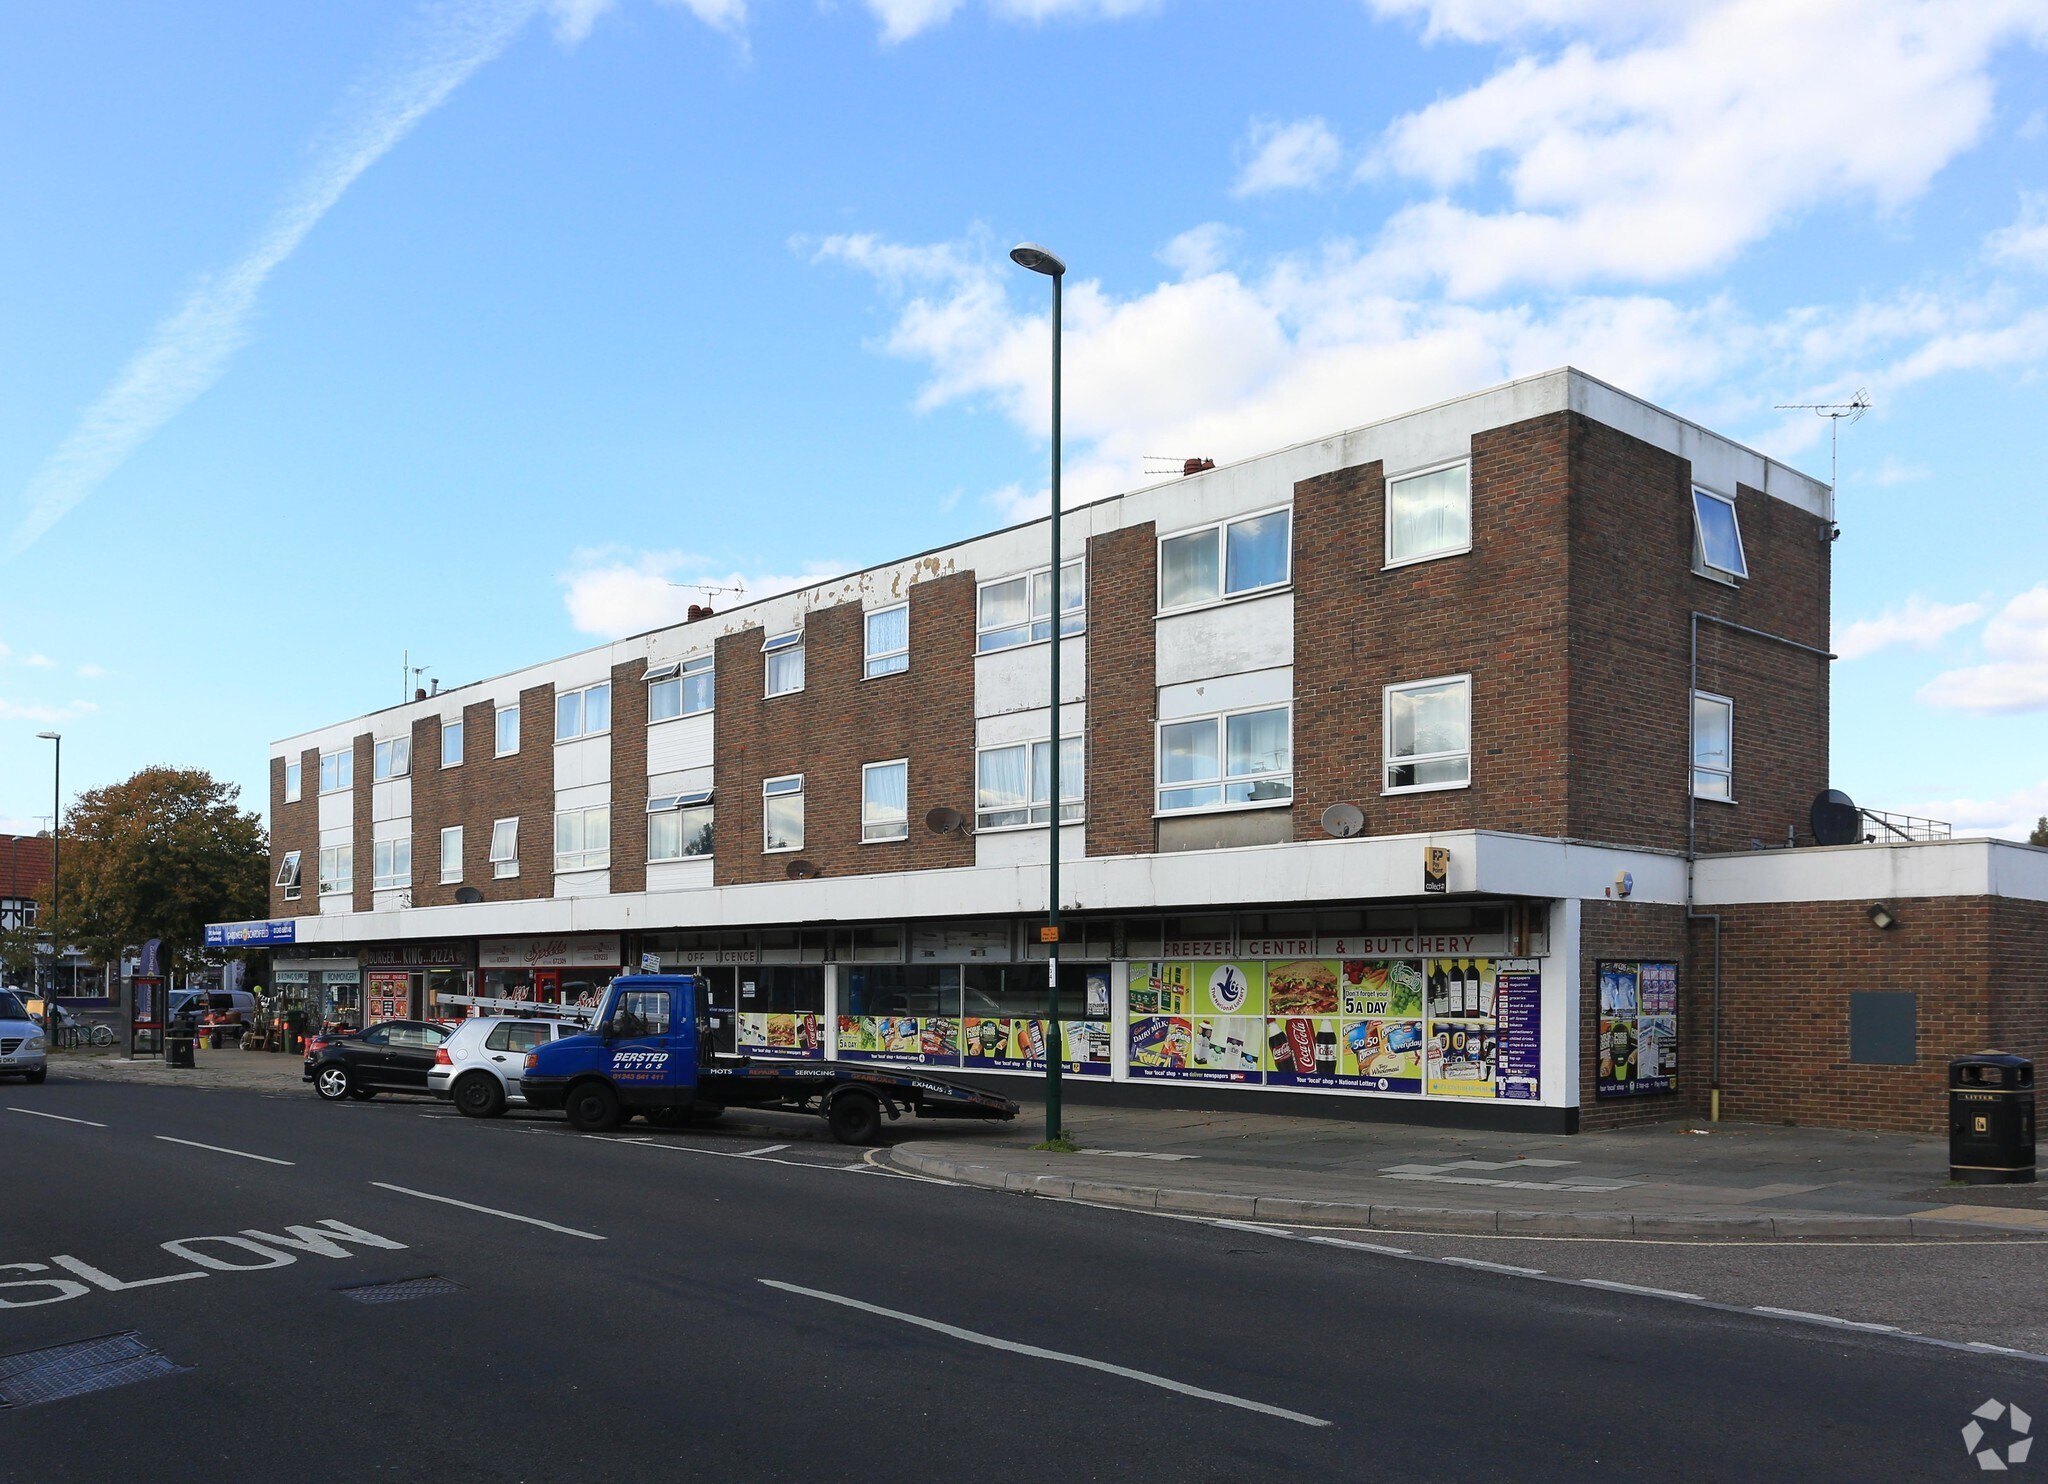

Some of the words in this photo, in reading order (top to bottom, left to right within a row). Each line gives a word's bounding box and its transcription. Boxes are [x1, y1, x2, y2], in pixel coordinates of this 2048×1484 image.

[1336, 939, 1346, 954] &
[1364, 936, 1474, 954] BUTCHERY
[430, 949, 455, 963] PIZZA
[524, 940, 567, 966] Splits
[687, 952, 705, 962] OFF
[1214, 997, 1235, 1011] National
[1234, 986, 1246, 1008] Lottery
[1345, 997, 1354, 1014] 5
[1356, 1002, 1363, 1014] A
[1366, 1002, 1387, 1014] DAY
[1151, 1021, 1169, 1033] MILK
[1133, 1028, 1150, 1042] DAIRY
[839, 1038, 844, 1048] 5
[1353, 1039, 1365, 1049] 50
[1366, 1036, 1378, 1047] 50
[612, 1052, 669, 1062] BERSTED
[612, 1062, 663, 1070] AUTOS
[1371, 1065, 1400, 1075] Wholemeal
[794, 1069, 836, 1077] SERVICING
[850, 1073, 897, 1084] GEARBOXES
[911, 1080, 953, 1096] EXHAUSS
[1360, 1080, 1377, 1088] Lottery
[0, 1218, 410, 1309] SLOW
